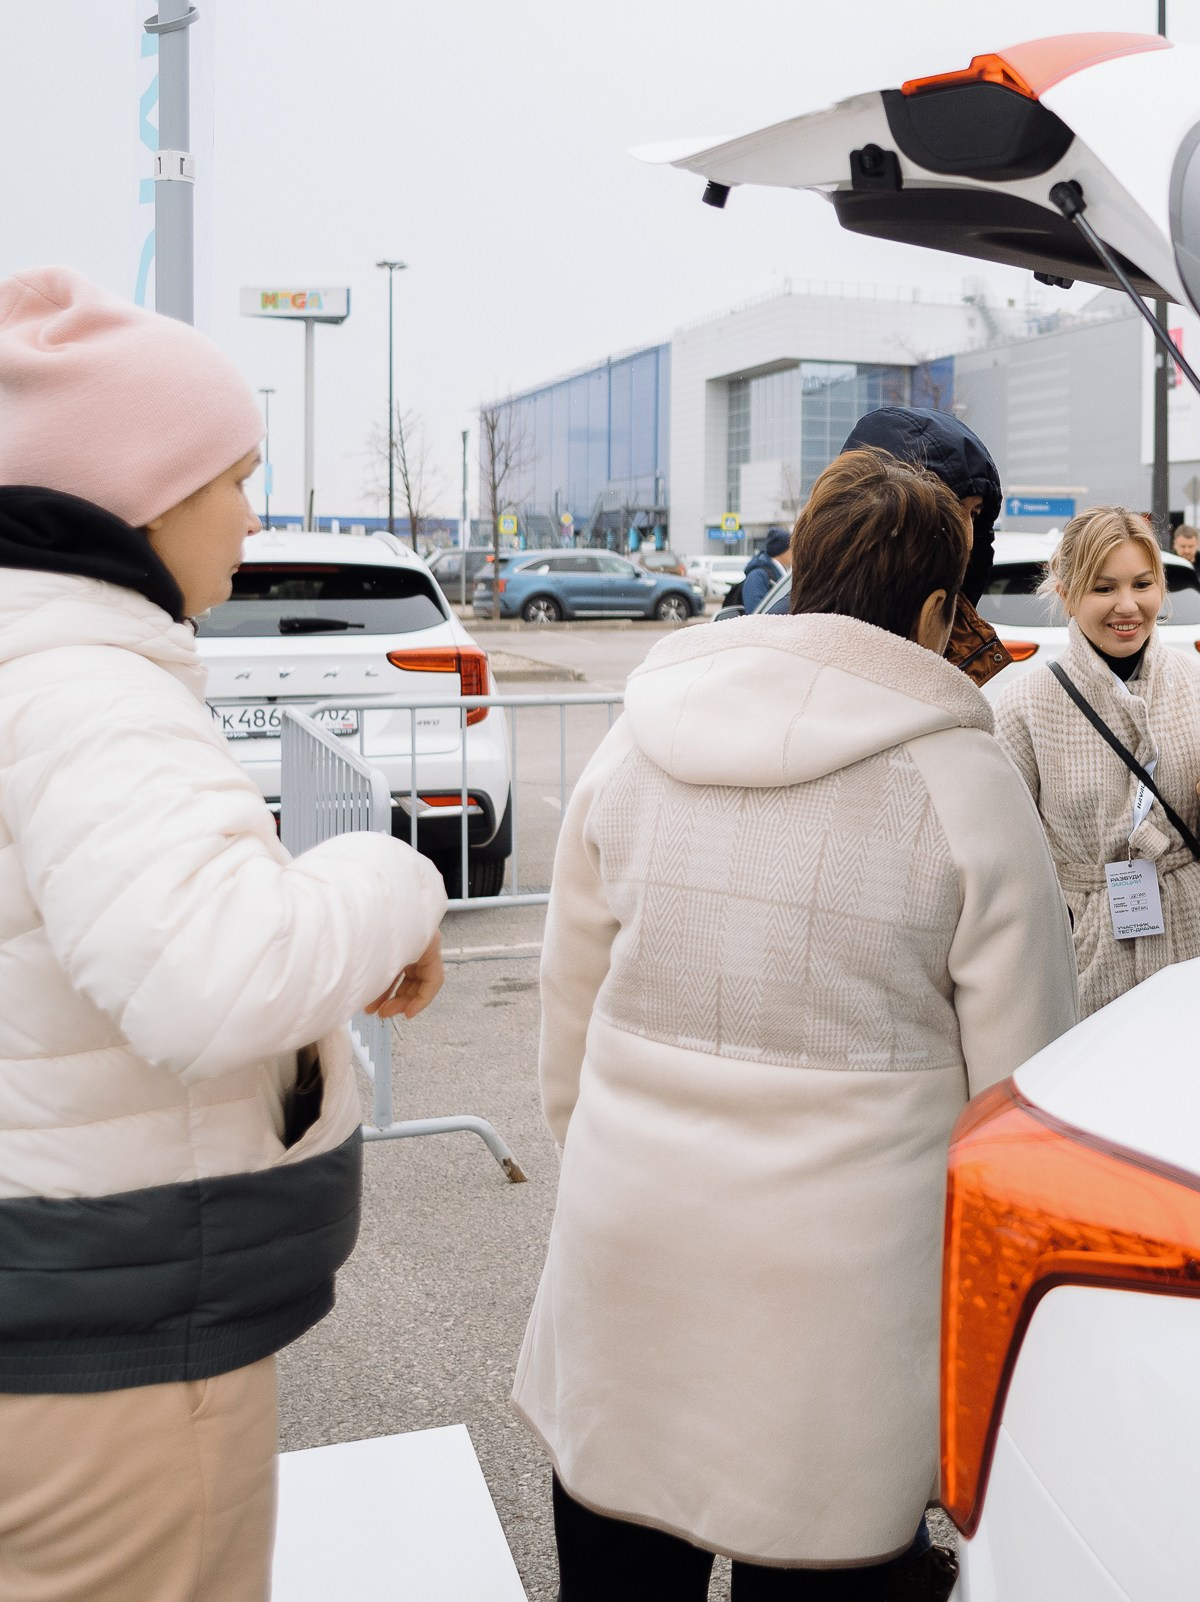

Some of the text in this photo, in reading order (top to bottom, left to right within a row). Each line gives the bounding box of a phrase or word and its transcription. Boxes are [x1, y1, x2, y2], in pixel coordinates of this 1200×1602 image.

[1110, 873, 1143, 883] РАЗБУДИ
[1111, 879, 1142, 888] ЭМОЦИИ
[1117, 922, 1149, 930] УЧАСТНИК
[1117, 924, 1160, 934] ТЕСТ-ДРАЙВА
